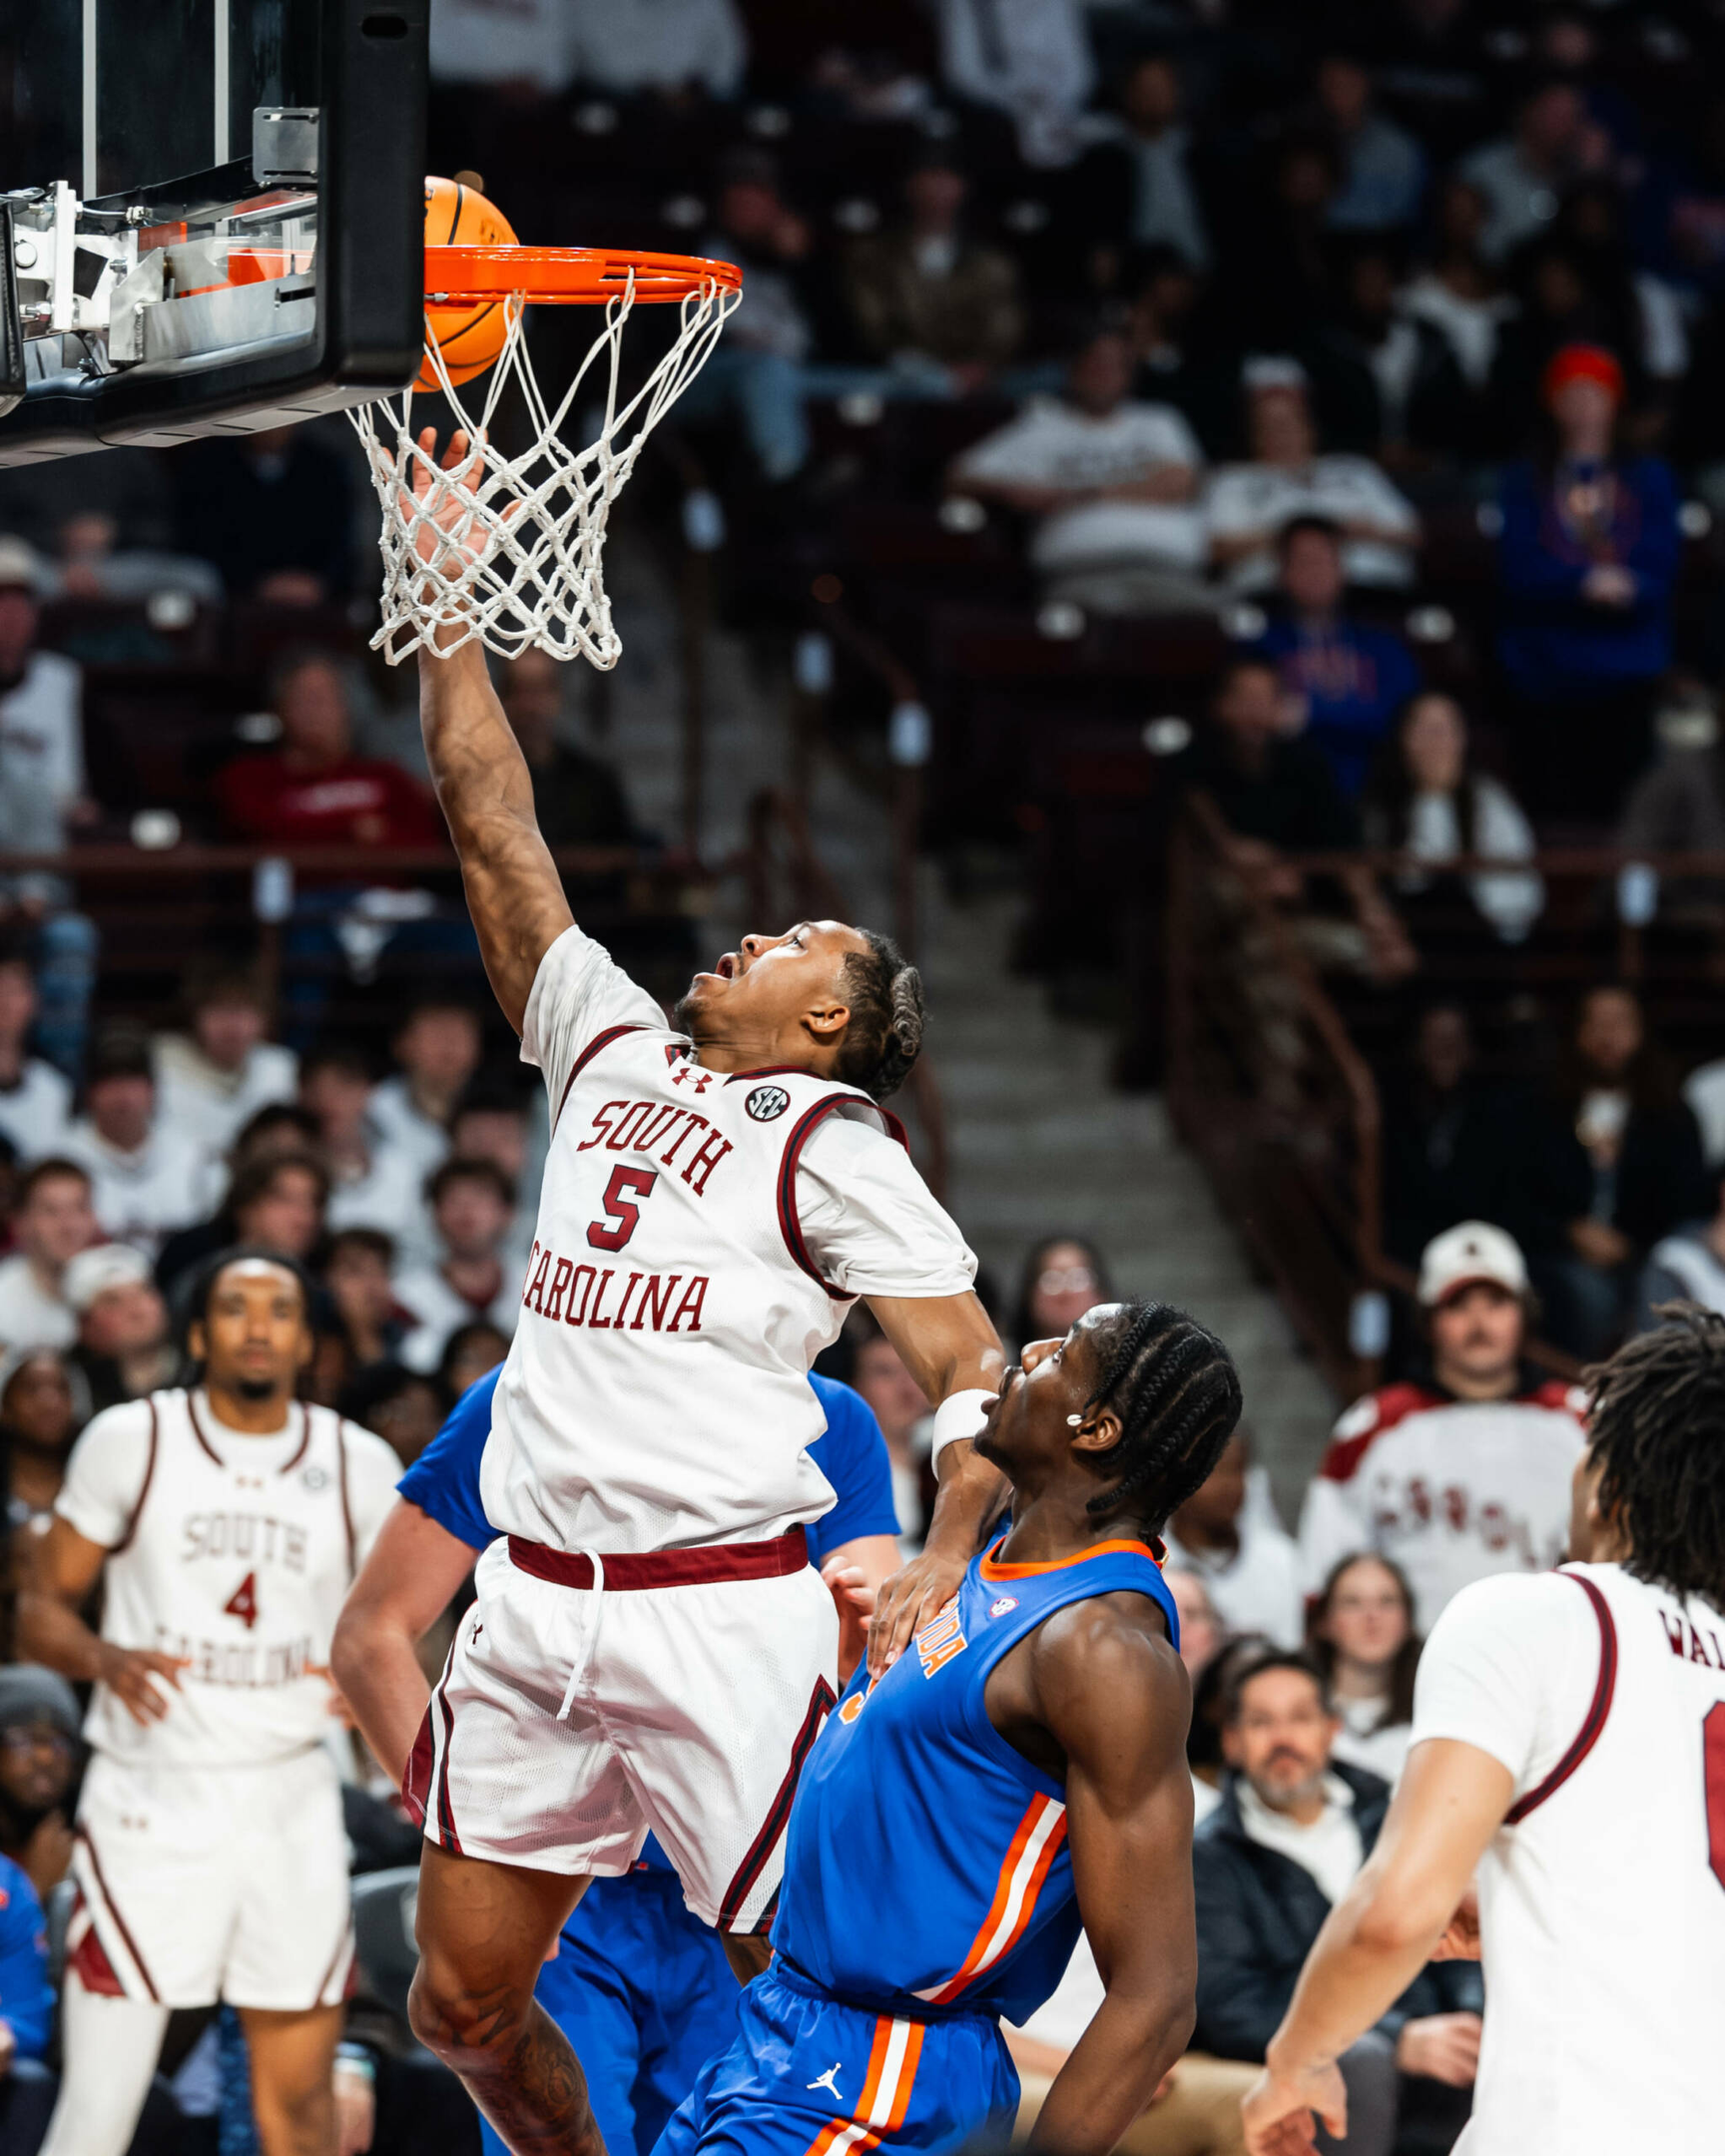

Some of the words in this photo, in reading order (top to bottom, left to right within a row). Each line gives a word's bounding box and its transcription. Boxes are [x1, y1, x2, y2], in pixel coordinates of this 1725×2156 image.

[576, 1100, 734, 1198] SOUTH
[586, 1163, 659, 1254] 5
[181, 1511, 307, 1575] SOUTH
[223, 1568, 260, 1631] 4
